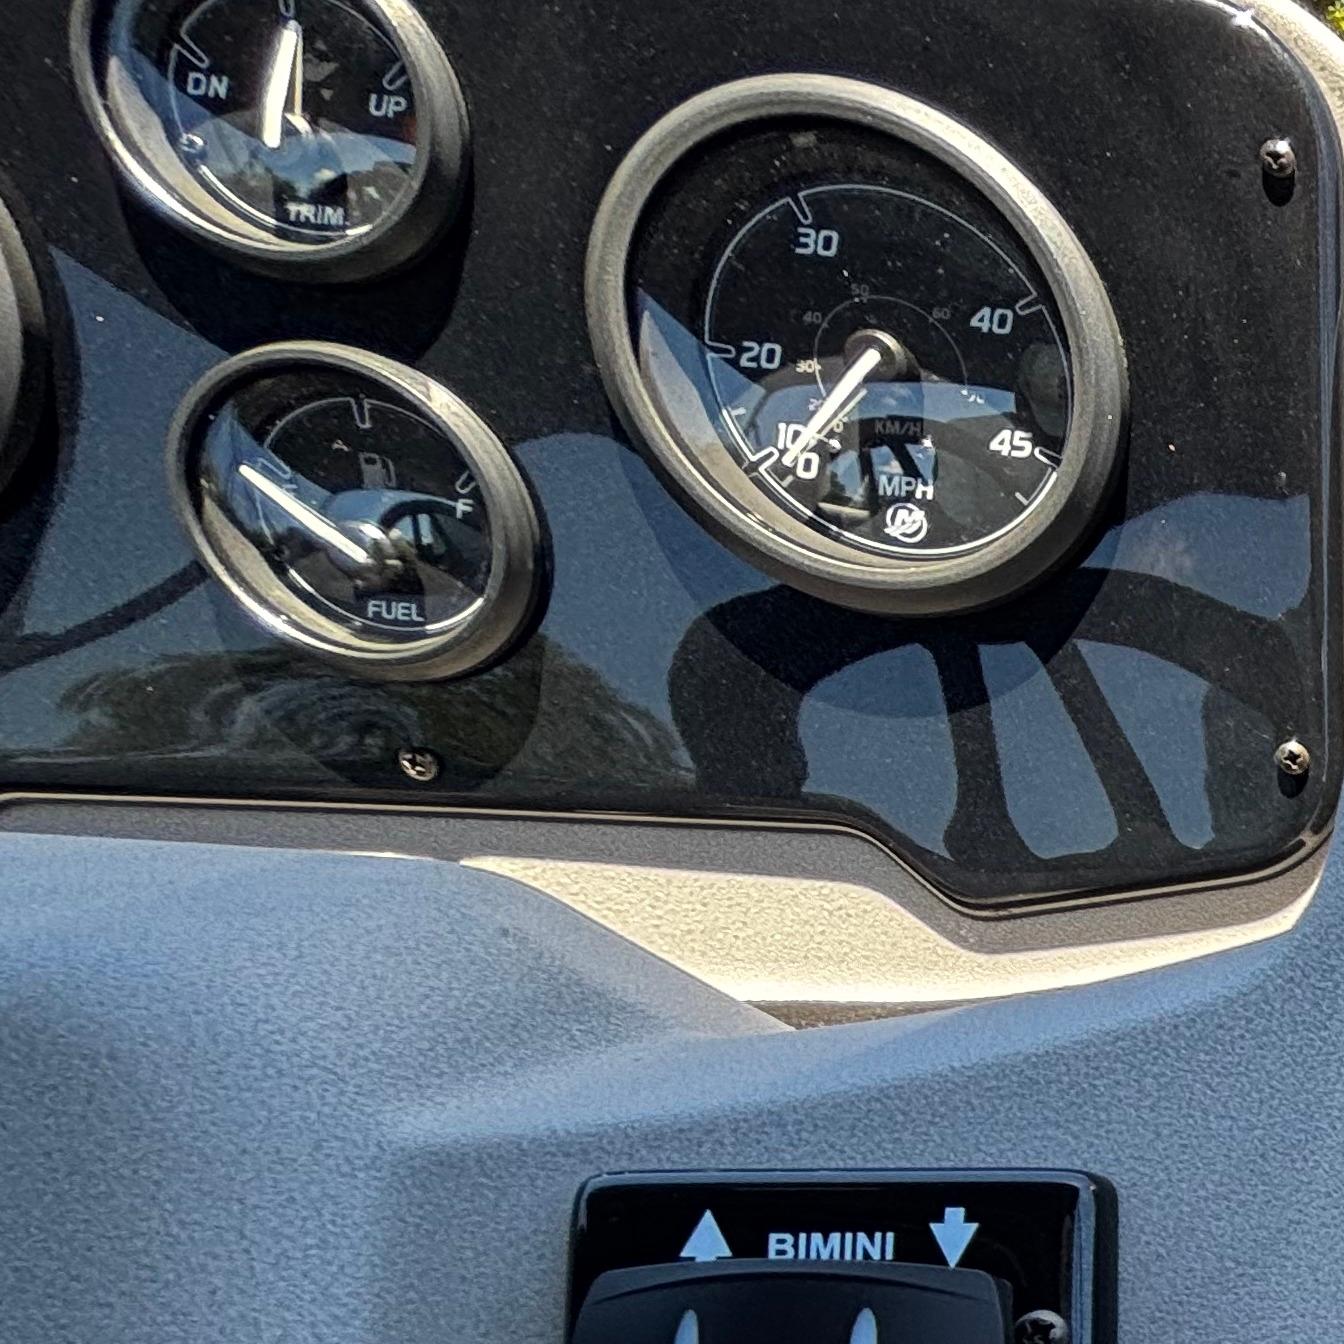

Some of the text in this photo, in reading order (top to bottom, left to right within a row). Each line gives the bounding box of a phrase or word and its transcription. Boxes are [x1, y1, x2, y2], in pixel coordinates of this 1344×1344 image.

[187, 71, 229, 99] DN
[369, 94, 407, 118] UP
[285, 202, 345, 226] TRIM
[794, 228, 839, 257] 30
[969, 307, 1013, 335] 40
[740, 342, 781, 370] 20
[874, 419, 922, 437] KM/H
[989, 429, 1033, 459] 45
[796, 451, 820, 480] 0
[878, 474, 934, 500] MPH
[456, 499, 474, 519] F
[368, 600, 425, 622] FUEL
[768, 1232, 894, 1261] BIMINI
